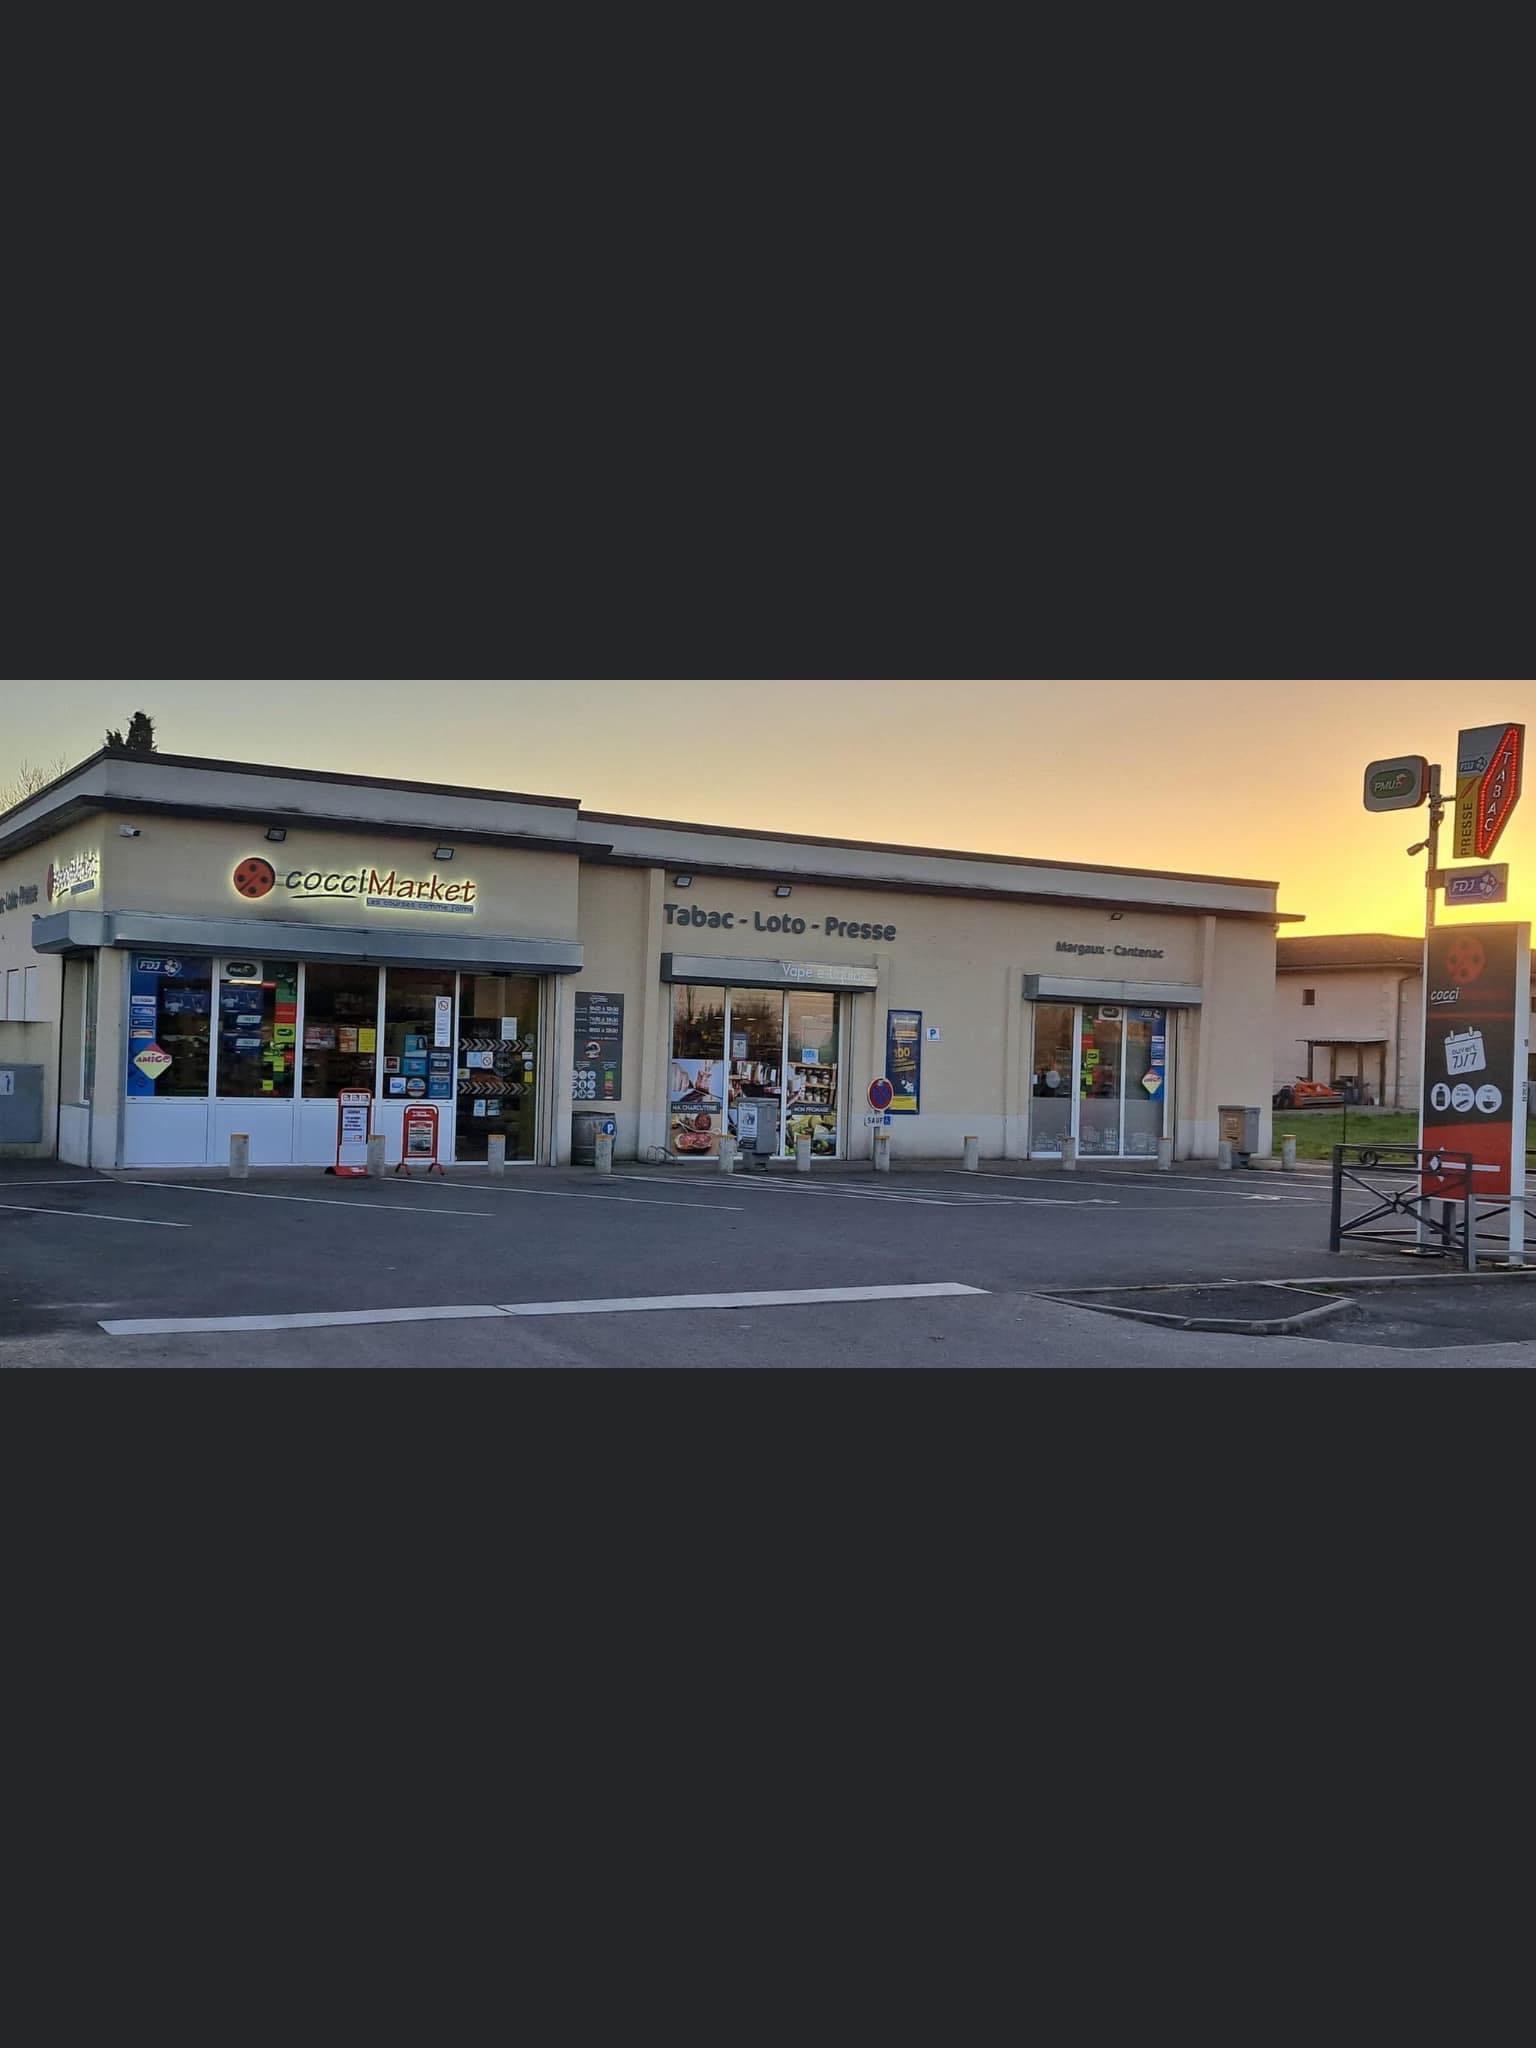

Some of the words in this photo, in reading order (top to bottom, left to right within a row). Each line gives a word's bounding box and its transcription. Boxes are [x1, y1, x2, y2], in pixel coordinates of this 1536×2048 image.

[1374, 781, 1395, 792] PMU
[1484, 752, 1512, 832] TABAC
[1460, 802, 1473, 856] PRESSE
[1452, 880, 1476, 893] FDJ
[663, 903, 734, 929] Tabac
[754, 911, 806, 934] Loto
[825, 916, 897, 942] Presse
[1055, 941, 1105, 956] Margaux
[1113, 945, 1164, 959] Cantenac
[140, 960, 161, 970] FDJ
[782, 962, 813, 983] Vape
[1431, 986, 1460, 1001] cocci
[930, 1029, 937, 1038] P
[136, 1055, 171, 1064] AMIGO
[607, 1123, 614, 1134] P
